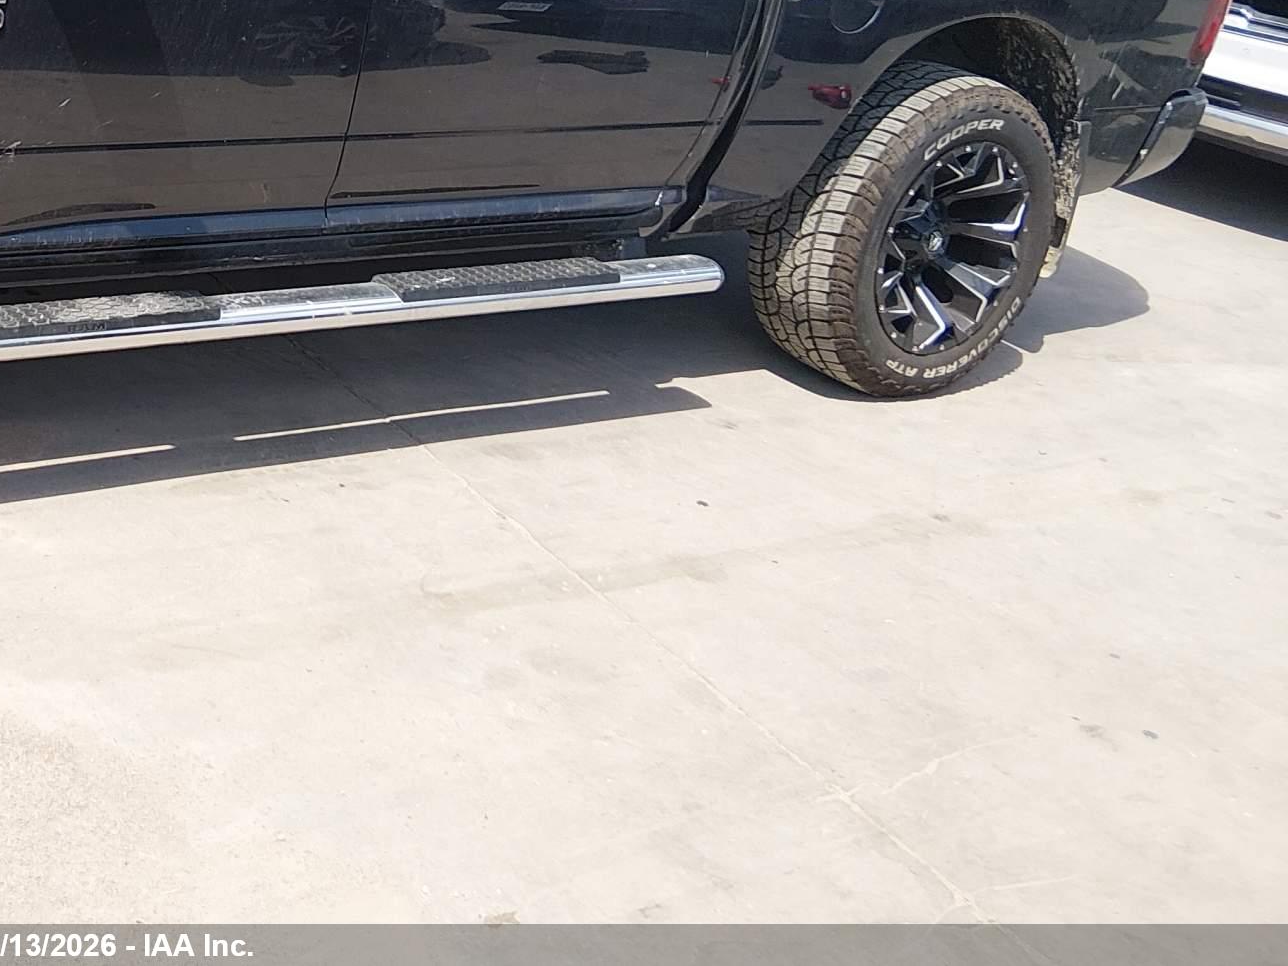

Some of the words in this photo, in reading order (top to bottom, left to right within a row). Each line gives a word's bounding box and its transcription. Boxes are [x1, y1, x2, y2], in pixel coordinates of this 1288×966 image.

[923, 118, 1005, 161] COOPER
[923, 296, 1021, 379] DISCOVERER
[885, 359, 919, 377] ATP
